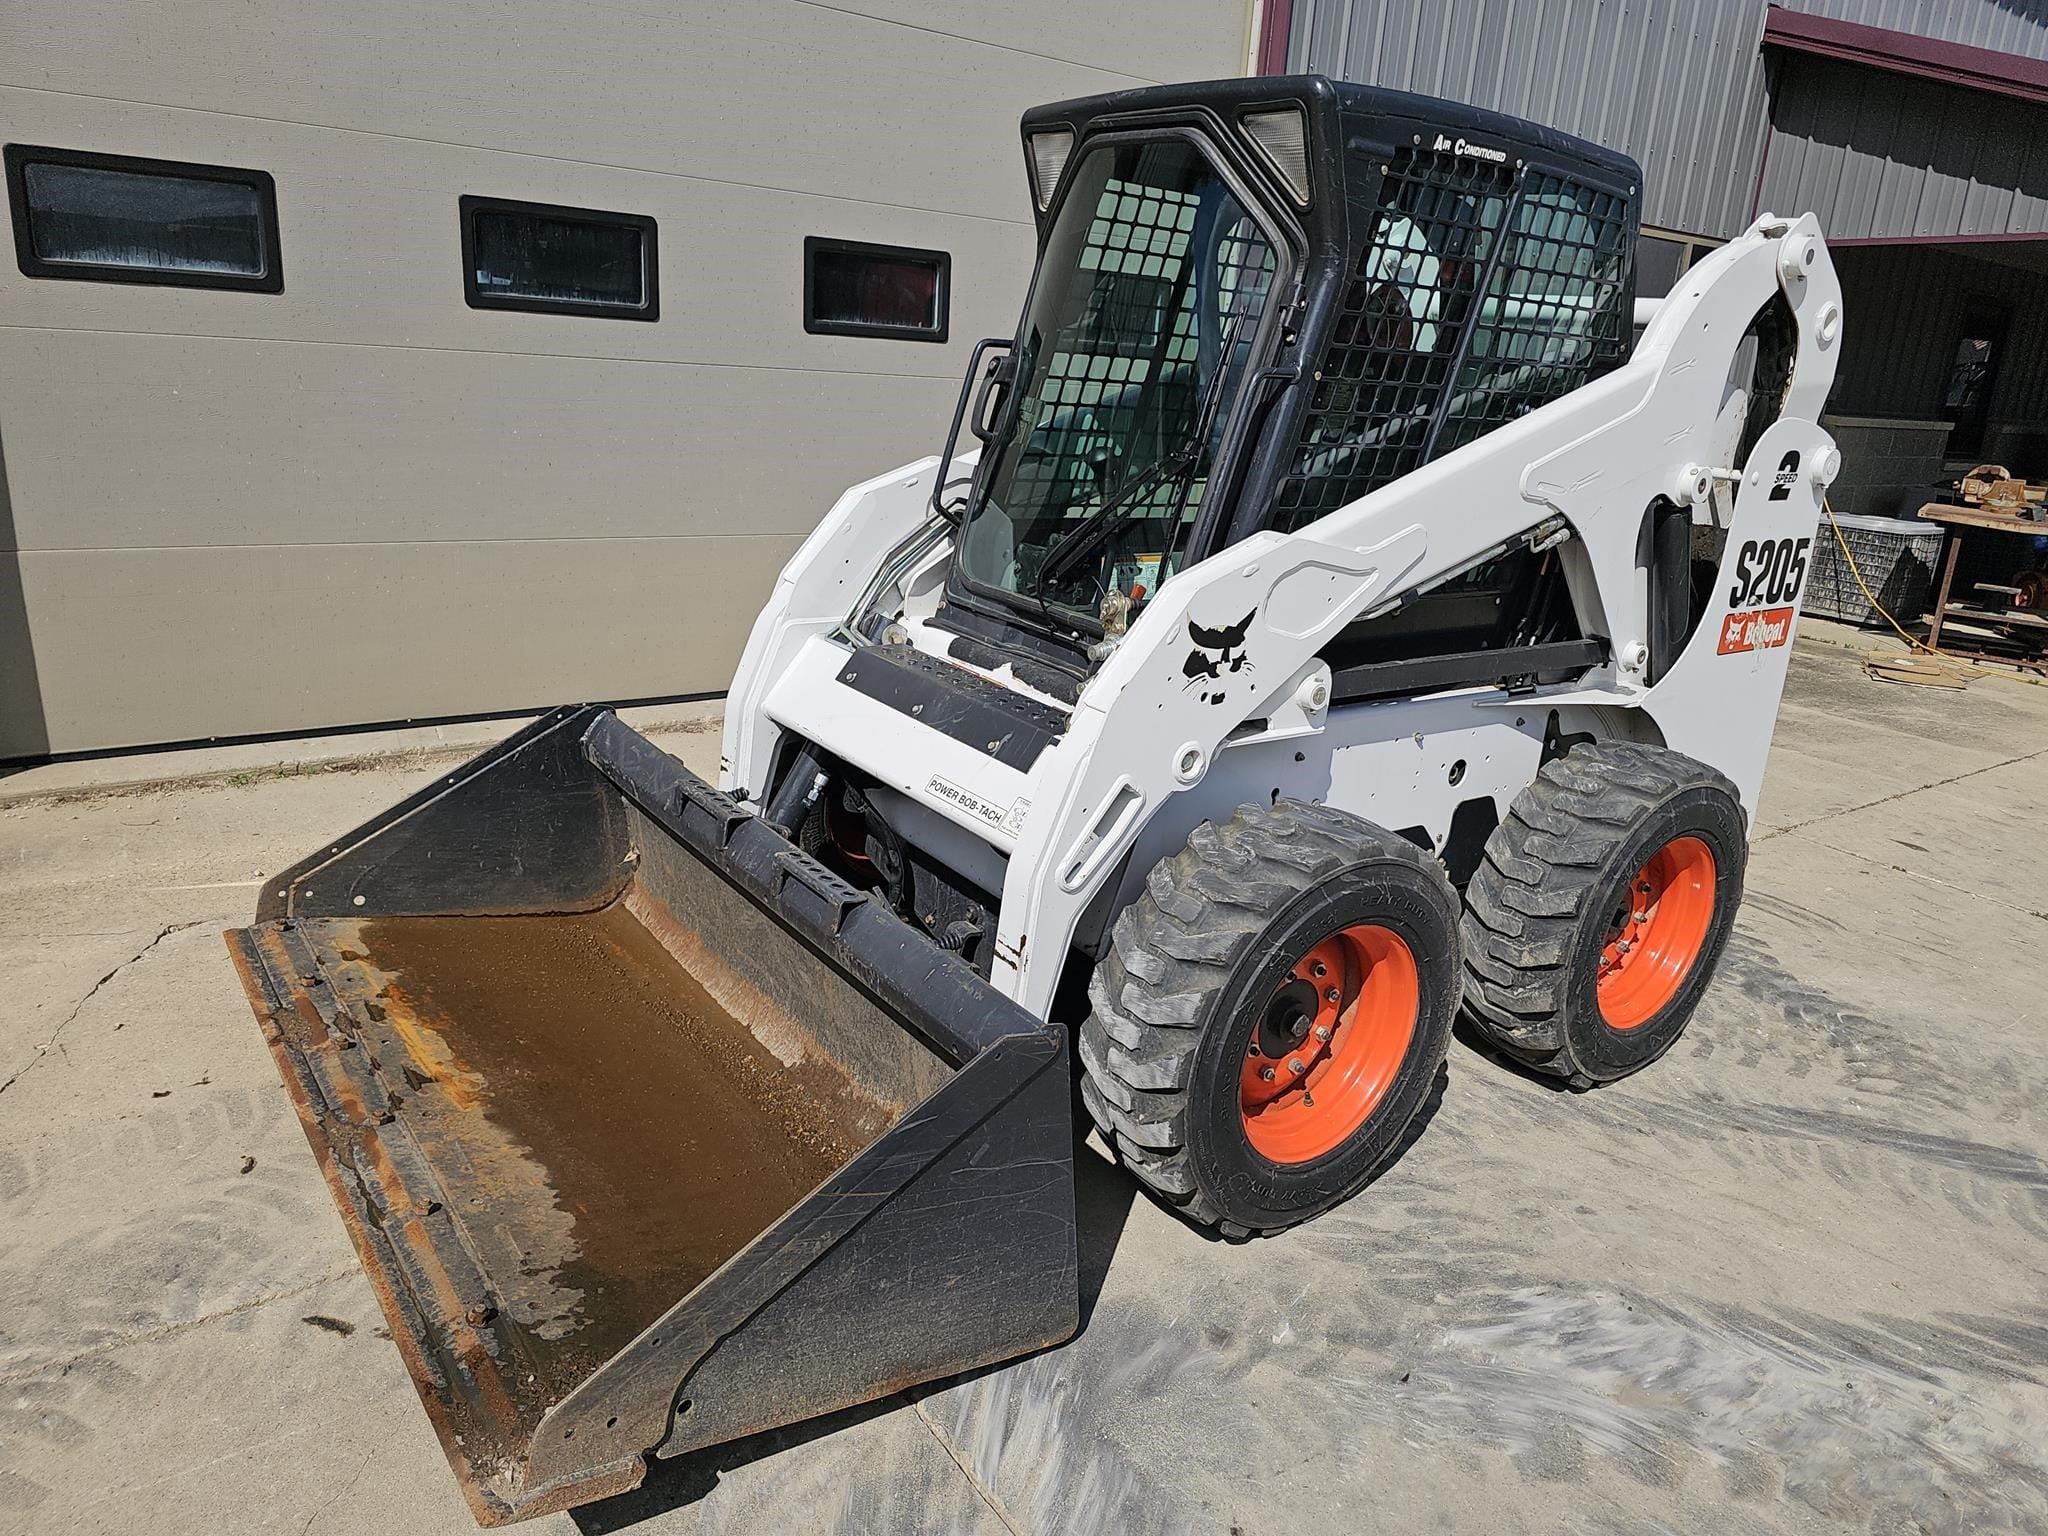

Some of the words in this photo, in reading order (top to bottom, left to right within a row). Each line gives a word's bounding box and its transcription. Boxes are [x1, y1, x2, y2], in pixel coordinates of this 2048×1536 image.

[1774, 473, 1798, 484] SPEED
[1729, 538, 1810, 608] S205
[928, 779, 959, 801] POWER
[958, 794, 1003, 823] BOB-TACH
